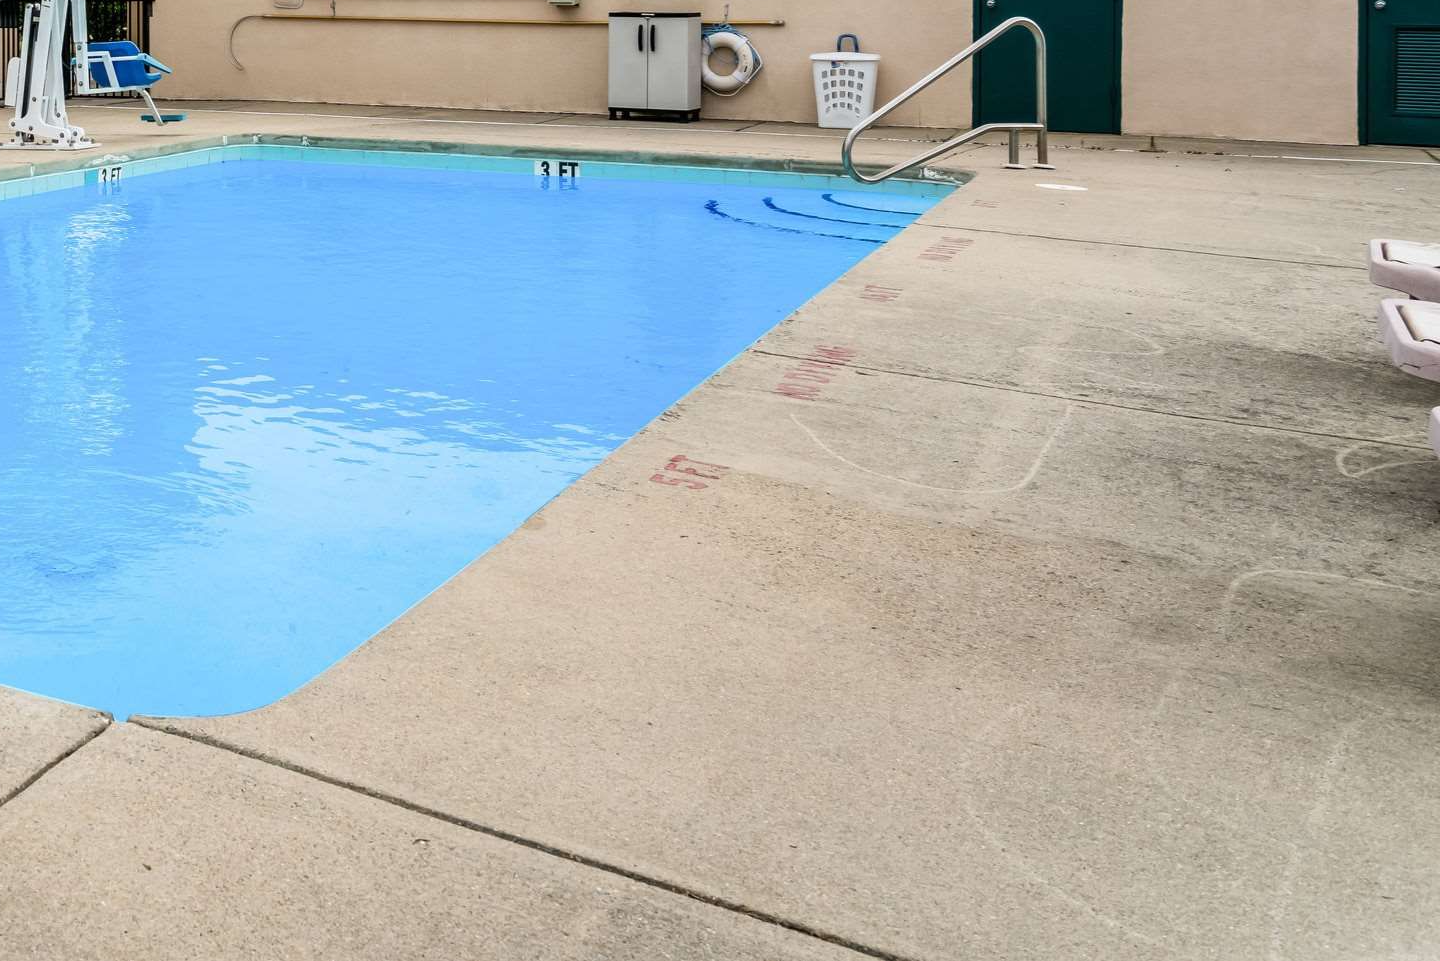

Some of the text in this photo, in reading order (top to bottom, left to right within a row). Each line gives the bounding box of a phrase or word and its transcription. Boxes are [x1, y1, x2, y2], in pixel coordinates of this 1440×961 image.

[110, 167, 122, 181] FT
[541, 161, 579, 177] 3 FT
